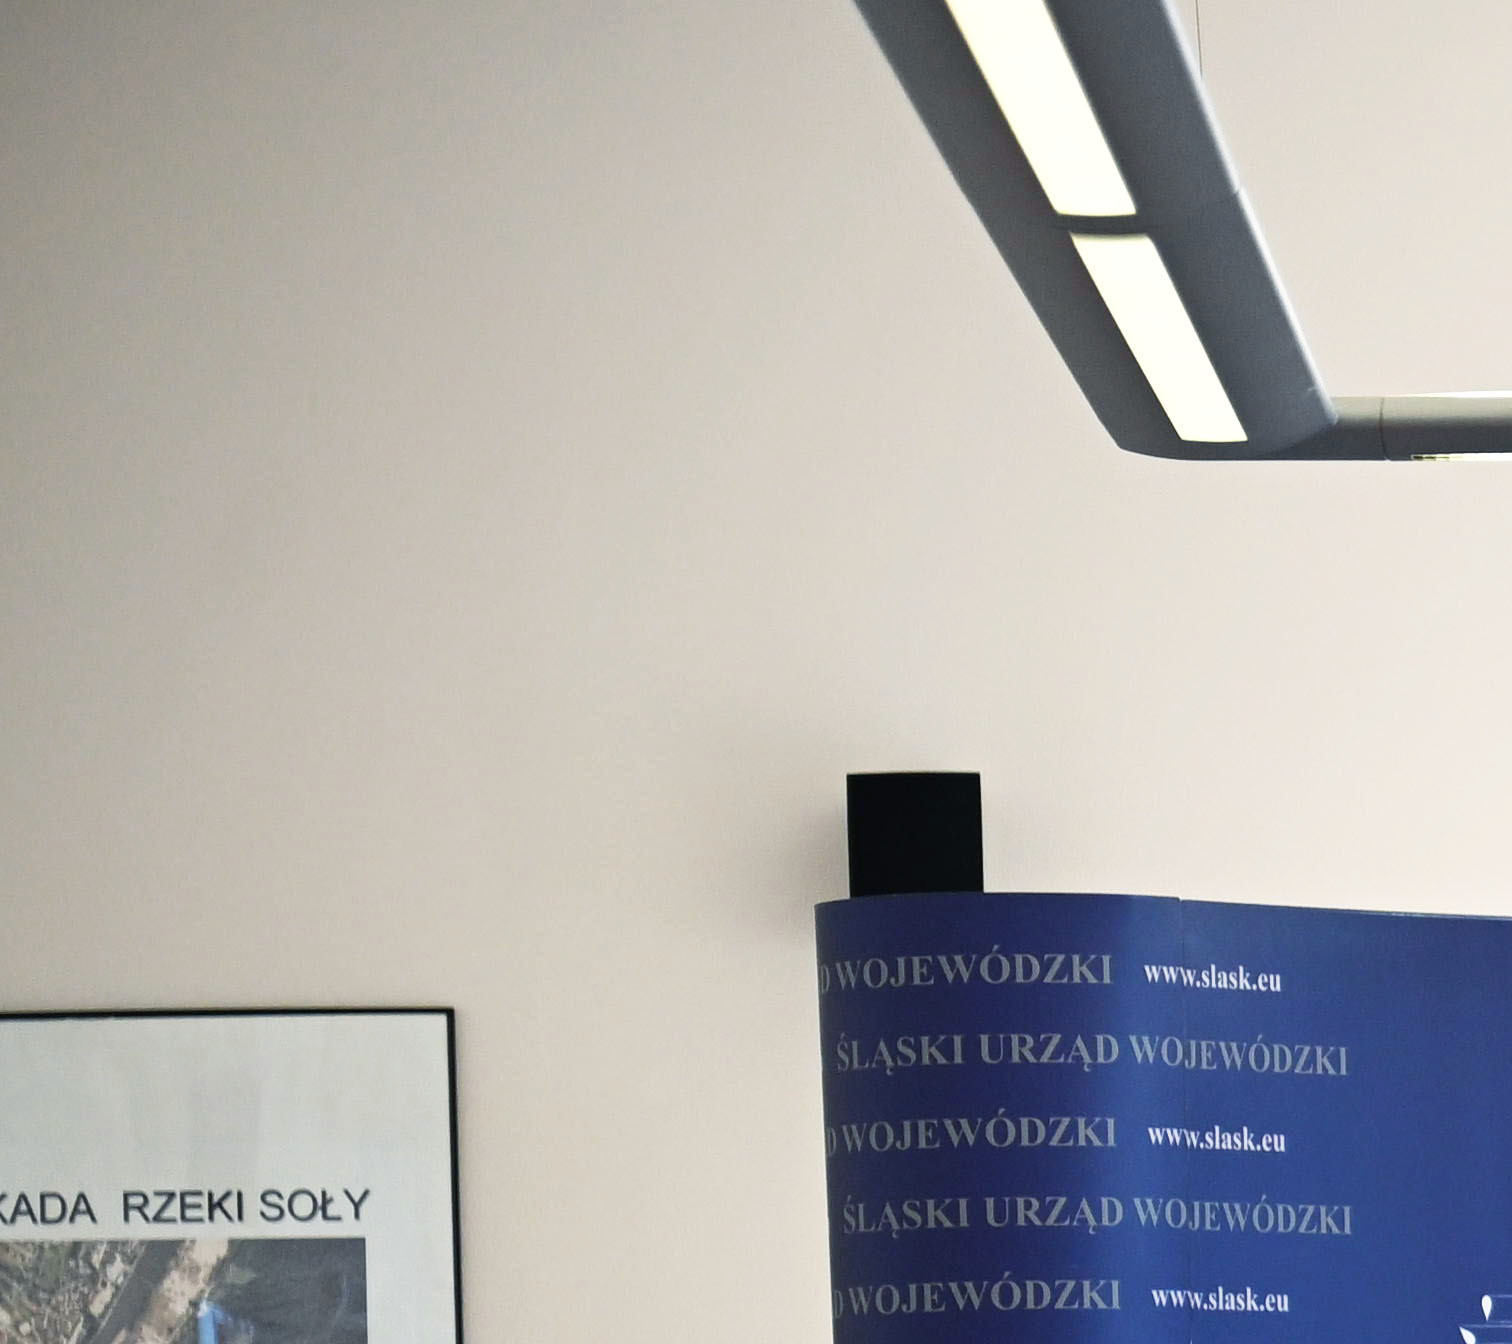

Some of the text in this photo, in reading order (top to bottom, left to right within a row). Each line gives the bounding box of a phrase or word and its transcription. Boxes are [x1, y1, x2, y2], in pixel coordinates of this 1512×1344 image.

[836, 945, 1281, 992] WOJEWÓDZKI www.slask.eu
[837, 1033, 1346, 1075] ŚLĄSKI URZĄD WOJEWÓDZKI
[843, 1108, 1285, 1152] WOJEWÓDZKI www.slask.eu
[0, 1188, 370, 1225] ADA RZEKI SOŁY
[844, 1194, 1351, 1238] ŚLĄSKI URZĄD WOJEWÓDZKI
[849, 1271, 1288, 1314] WOJEWÓDZKI www.slask.eu
